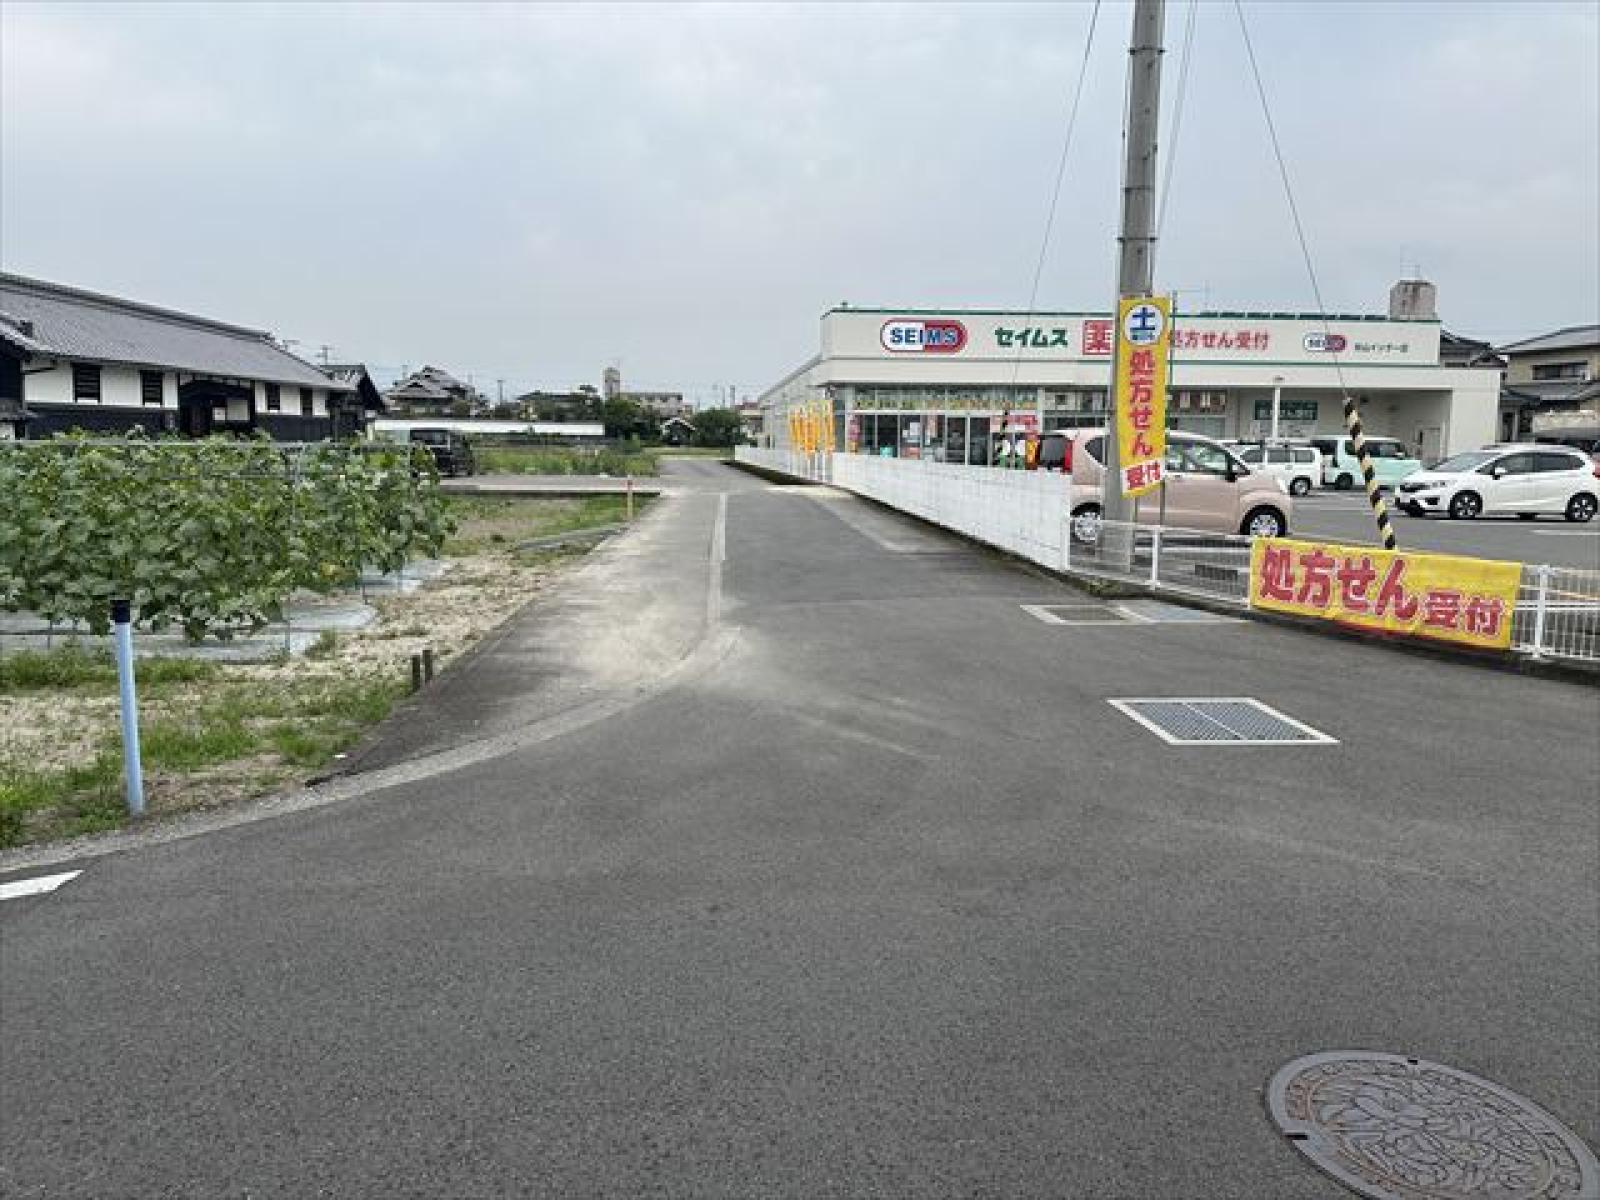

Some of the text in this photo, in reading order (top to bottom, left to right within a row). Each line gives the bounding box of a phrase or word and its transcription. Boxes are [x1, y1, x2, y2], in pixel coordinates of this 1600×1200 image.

[1130, 306, 1156, 331] 土
[890, 327, 957, 344] SEIMS
[994, 326, 1069, 347] セイムス
[1129, 349, 1156, 457] 処方せん
[1126, 461, 1161, 490] 受付
[1259, 545, 1506, 637] 処方せん 受付
